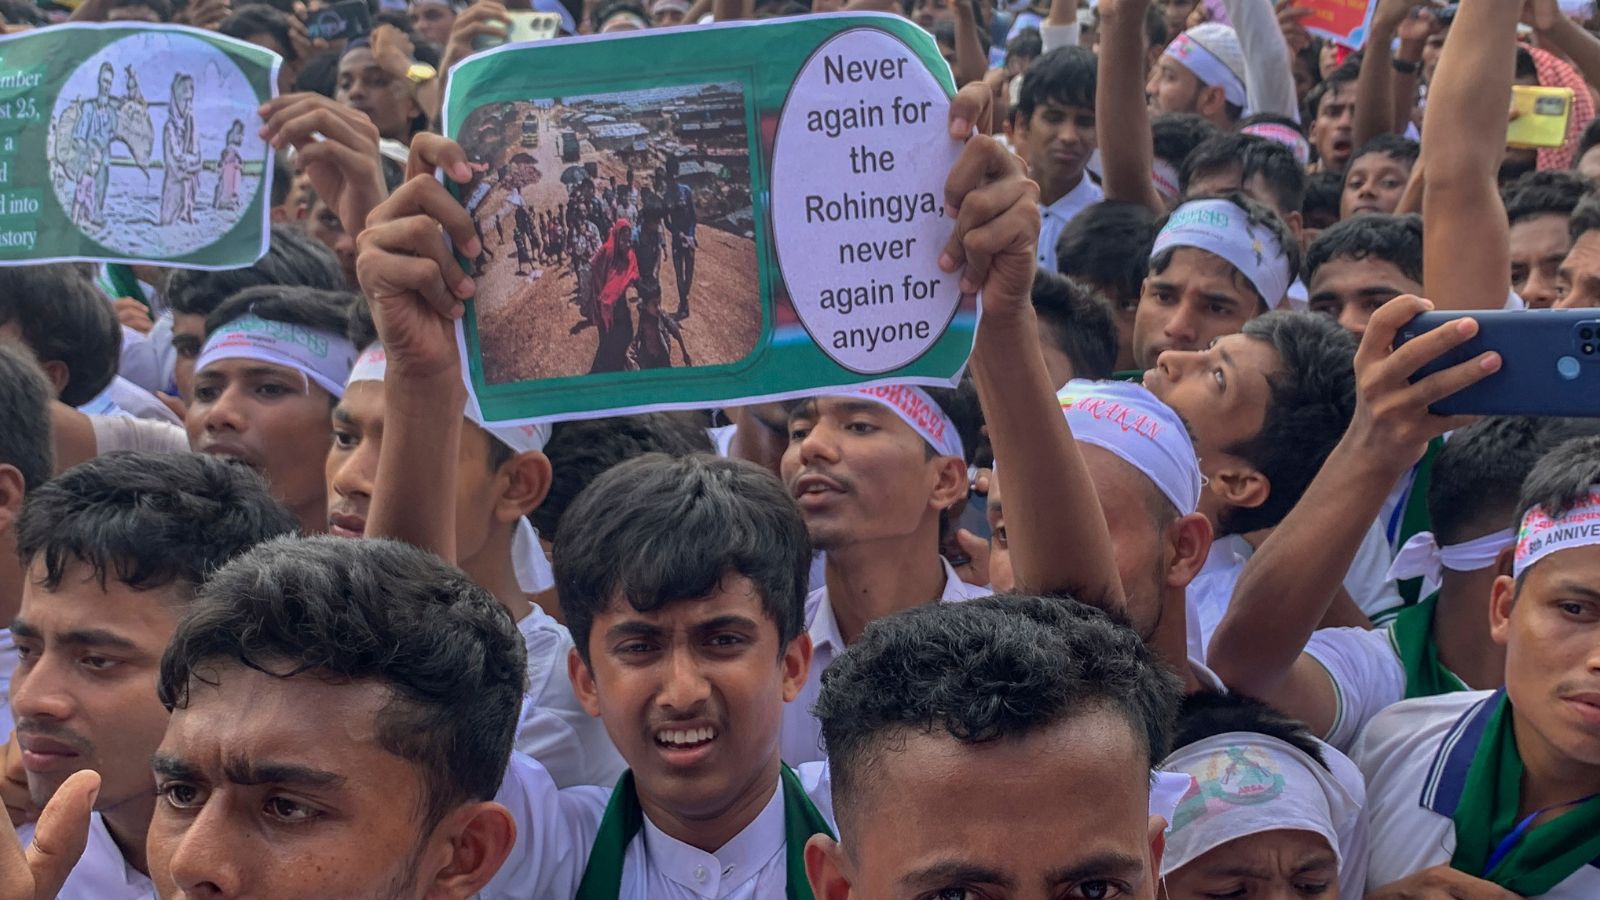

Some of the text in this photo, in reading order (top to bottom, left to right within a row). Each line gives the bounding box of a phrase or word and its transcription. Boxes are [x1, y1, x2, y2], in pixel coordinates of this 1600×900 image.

[824, 54, 909, 85] Never
[16, 97, 40, 120] 25,
[807, 96, 932, 138] again for
[4, 135, 13, 151] a
[849, 145, 895, 174] the
[10, 193, 38, 214] into
[805, 191, 944, 223] Rohingya,
[840, 237, 916, 264] never
[820, 275, 940, 314] again for
[832, 320, 930, 352] anyone
[1545, 523, 1600, 546] ANNIVE
